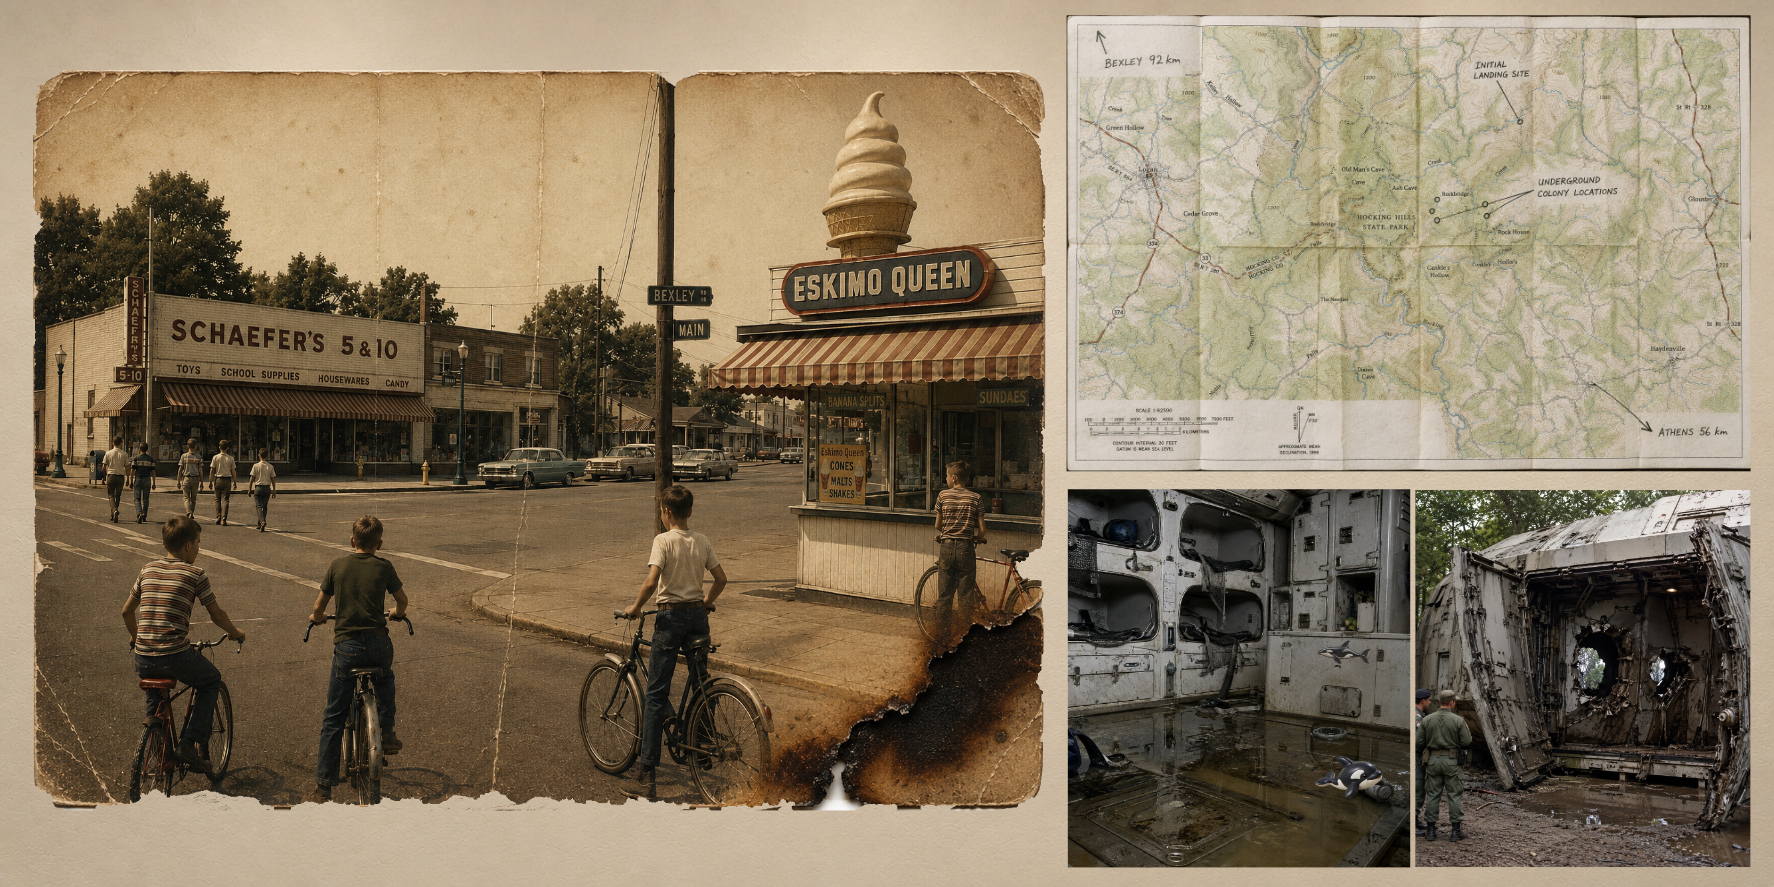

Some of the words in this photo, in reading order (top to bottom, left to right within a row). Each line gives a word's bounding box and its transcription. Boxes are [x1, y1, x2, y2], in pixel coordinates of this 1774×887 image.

[1104, 57, 1143, 68] BEXLEY
[1149, 55, 1163, 65] 92
[1166, 54, 1181, 64] km
[1474, 61, 1507, 70] INITIAL
[1473, 71, 1509, 80] LANDING
[1512, 70, 1530, 78] SITE
[1538, 176, 1600, 186] UNDERGROUND
[1537, 188, 1569, 197] COLONY
[1573, 187, 1618, 196] LOCATIONS
[794, 268, 882, 302] ESKIMO
[891, 259, 971, 297] QUEEN
[654, 289, 695, 302] BEXLEY
[679, 323, 704, 337] MAIN
[172, 319, 325, 353] SCHAEFER'S
[341, 335, 354, 355] 5
[359, 341, 371, 357] &
[377, 339, 398, 359] 10
[176, 364, 201, 375] TOYS
[221, 367, 256, 379] SCHOOL
[262, 370, 300, 381] SUPPLIES
[119, 370, 142, 382] 5-10
[318, 374, 370, 386] HOUSEWARES
[385, 379, 410, 388] CANDY
[828, 396, 857, 408] BANANA
[860, 395, 885, 407] SPLITS
[979, 390, 1026, 404] SUNDAES
[1658, 427, 1694, 437] ATHENS
[1699, 426, 1711, 436] 56
[1714, 426, 1728, 436] km
[821, 447, 843, 457] Eskimo
[844, 447, 864, 457] Queen
[830, 461, 854, 471] CONES
[831, 476, 852, 486] MALTS
[829, 489, 855, 499] SHAKES
